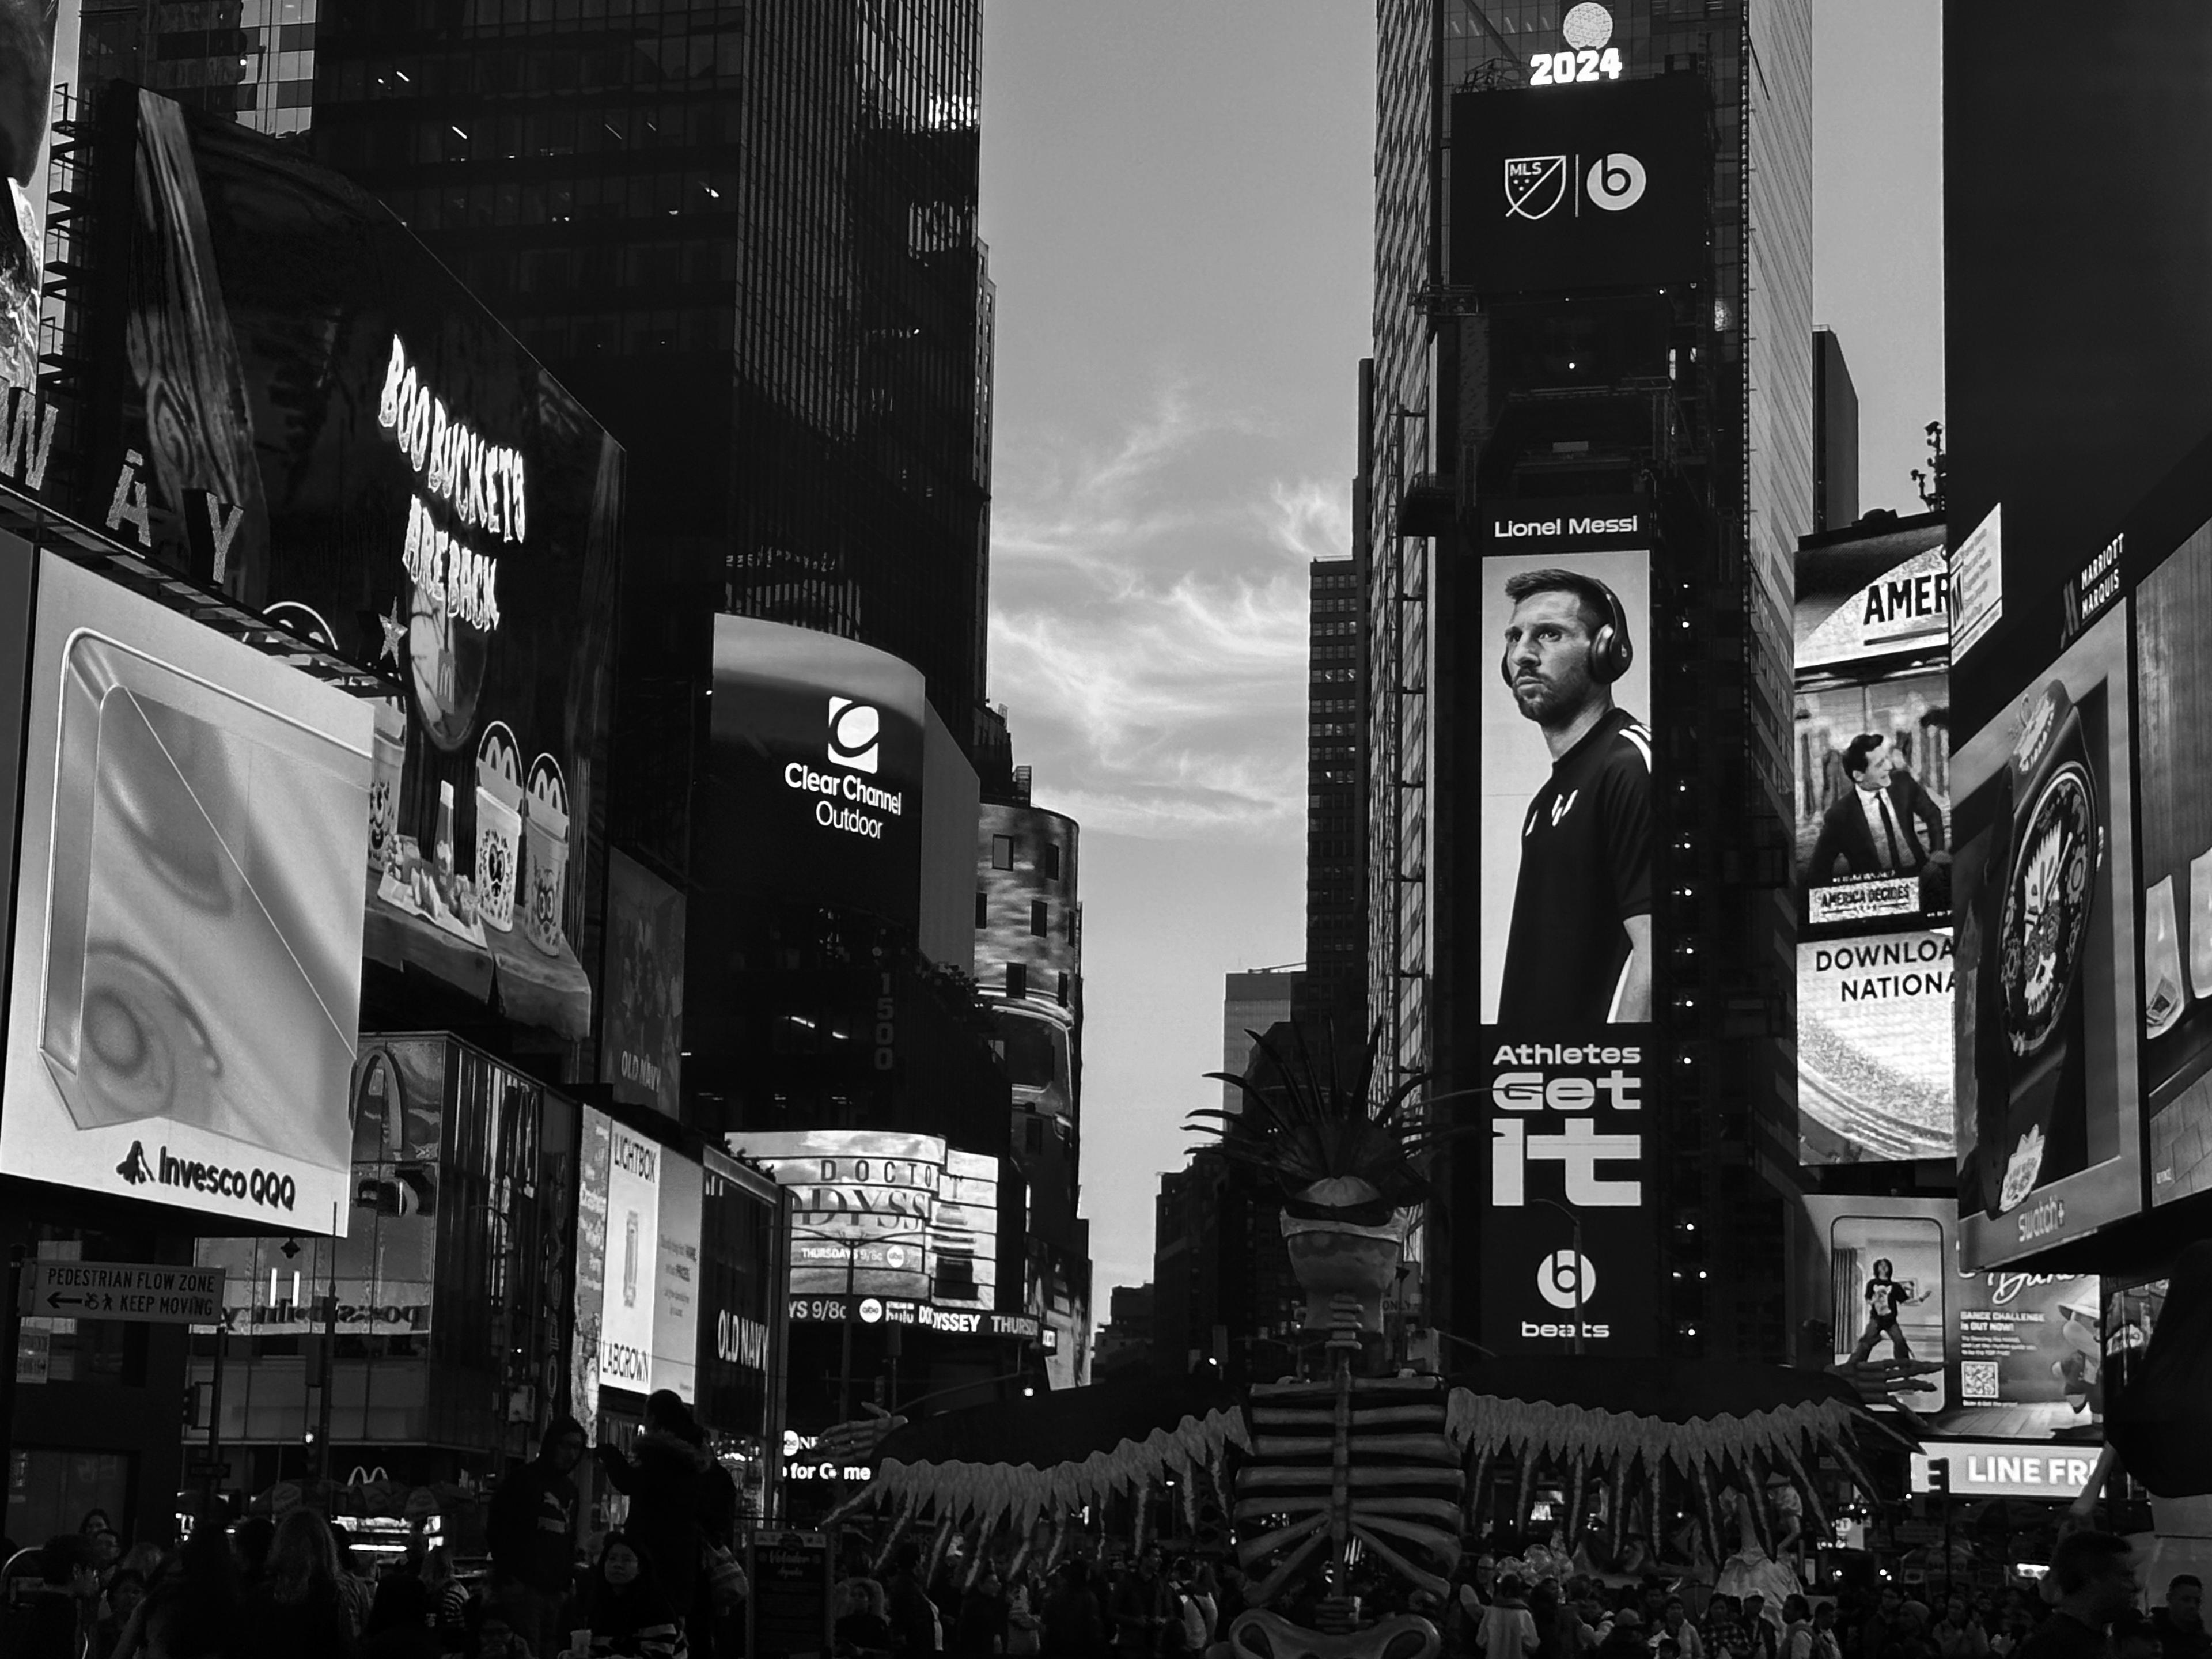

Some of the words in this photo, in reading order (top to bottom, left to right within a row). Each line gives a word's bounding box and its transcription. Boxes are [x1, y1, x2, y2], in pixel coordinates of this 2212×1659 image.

[1530, 48, 1622, 86] 2024
[1510, 163, 1542, 176] MLS
[379, 334, 430, 471] BOO
[428, 397, 525, 543] BUCKETS
[1495, 519, 1560, 537] Lionel
[1569, 515, 1637, 535] Messi
[402, 494, 448, 600] ARE
[447, 539, 501, 632] BACK
[2081, 533, 2124, 590] MARRIOTT
[1863, 573, 1948, 626] AMER
[2082, 569, 2120, 619] MARQUIS
[785, 762, 840, 796] Clear
[843, 775, 902, 815] Channel
[816, 800, 883, 839] Outdoor
[1821, 891, 1866, 907] AMERICA
[1869, 884, 1910, 902] DECIDES
[874, 972, 894, 1071] 1500
[621, 1050, 639, 1081] OLD
[639, 1058, 662, 1094] NAVY
[1493, 1044, 1641, 1065] Athletes
[1493, 1070, 1641, 1110] Get
[614, 1132, 657, 1183] LIGHTBOX
[159, 1146, 247, 1199] Invesco
[249, 1169, 295, 1211] QQQ
[2018, 1196, 2058, 1243] swatch
[48, 1268, 132, 1288] PEDESTRIAN
[137, 1272, 173, 1290] FLOW
[179, 1275, 215, 1293] ZONE
[120, 1296, 154, 1313] KEEP
[160, 1297, 213, 1316] MOVING
[812, 1300, 847, 1321] 9/8c
[885, 1309, 914, 1324] hulu
[1960, 1310, 1991, 1320] DANCE
[1992, 1311, 2044, 1322] CHALLENGE
[718, 1309, 739, 1363] OLD
[741, 1317, 770, 1372] NAVY
[1522, 1321, 1609, 1338] beats
[790, 1463, 816, 1479] for
[1968, 1455, 2041, 1484] LINE
